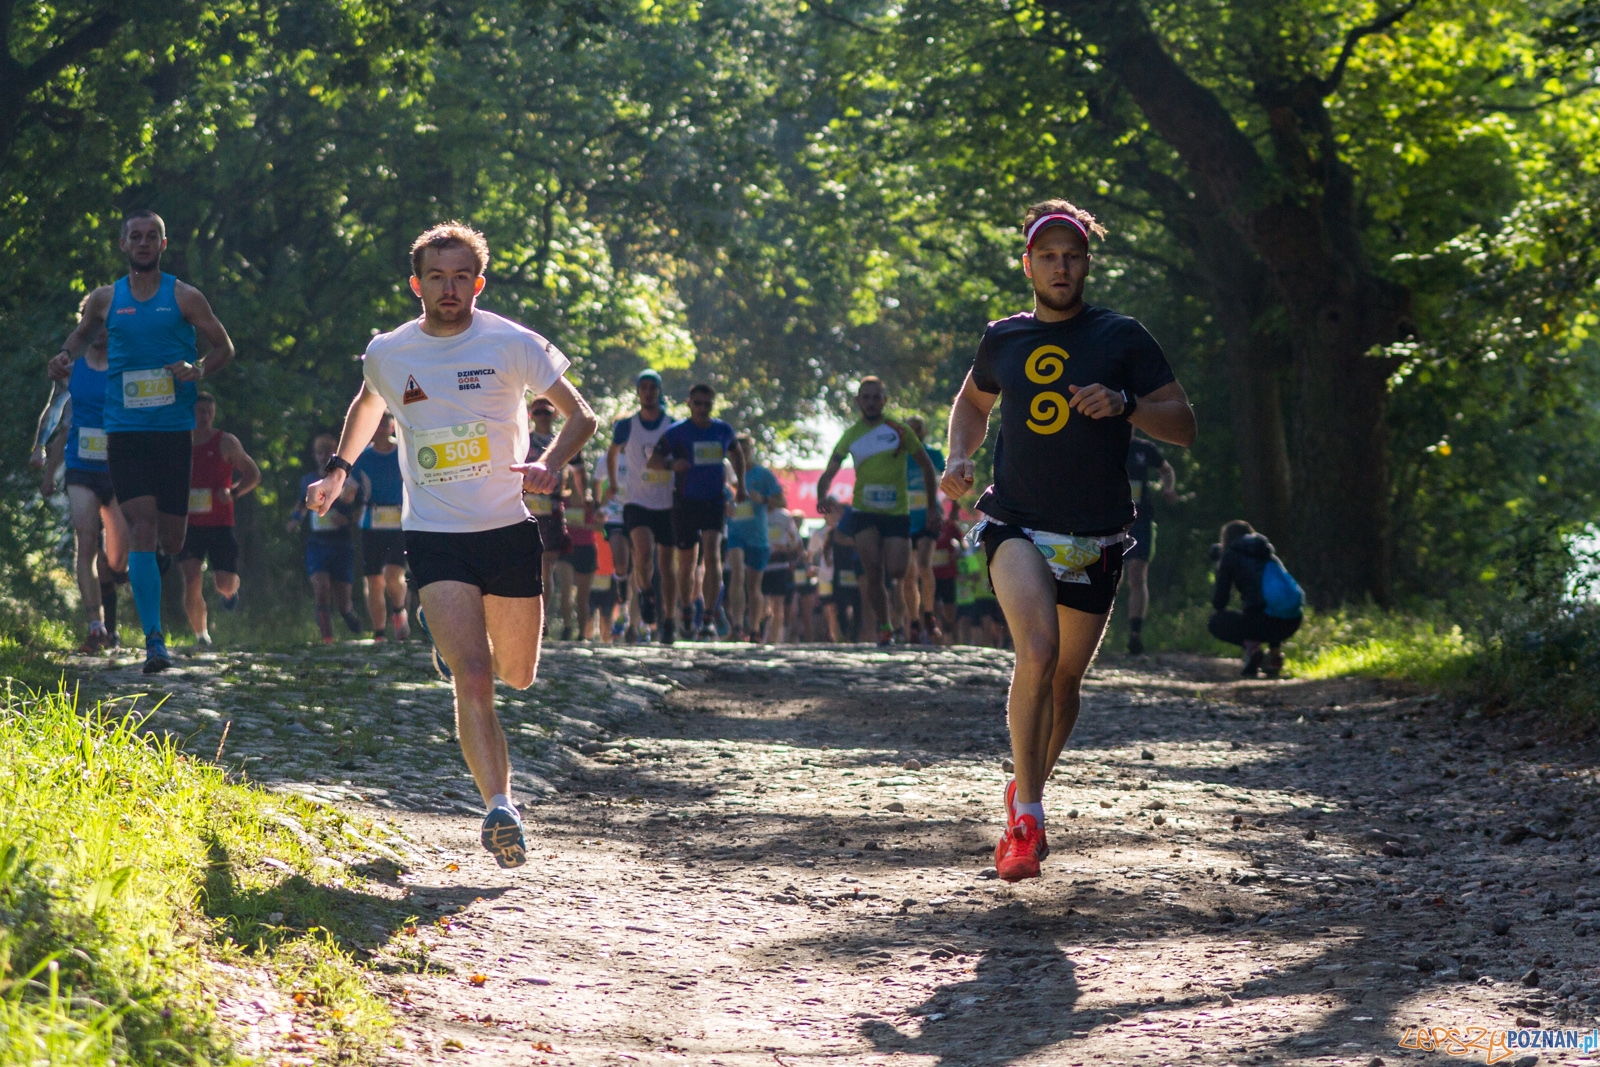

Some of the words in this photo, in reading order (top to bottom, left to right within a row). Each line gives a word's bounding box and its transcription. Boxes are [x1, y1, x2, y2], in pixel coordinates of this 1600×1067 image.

[457, 369, 496, 377] DZIEWICZA
[145, 381, 168, 393] 273
[446, 440, 481, 462] 506
[1065, 546, 1093, 568] 257
